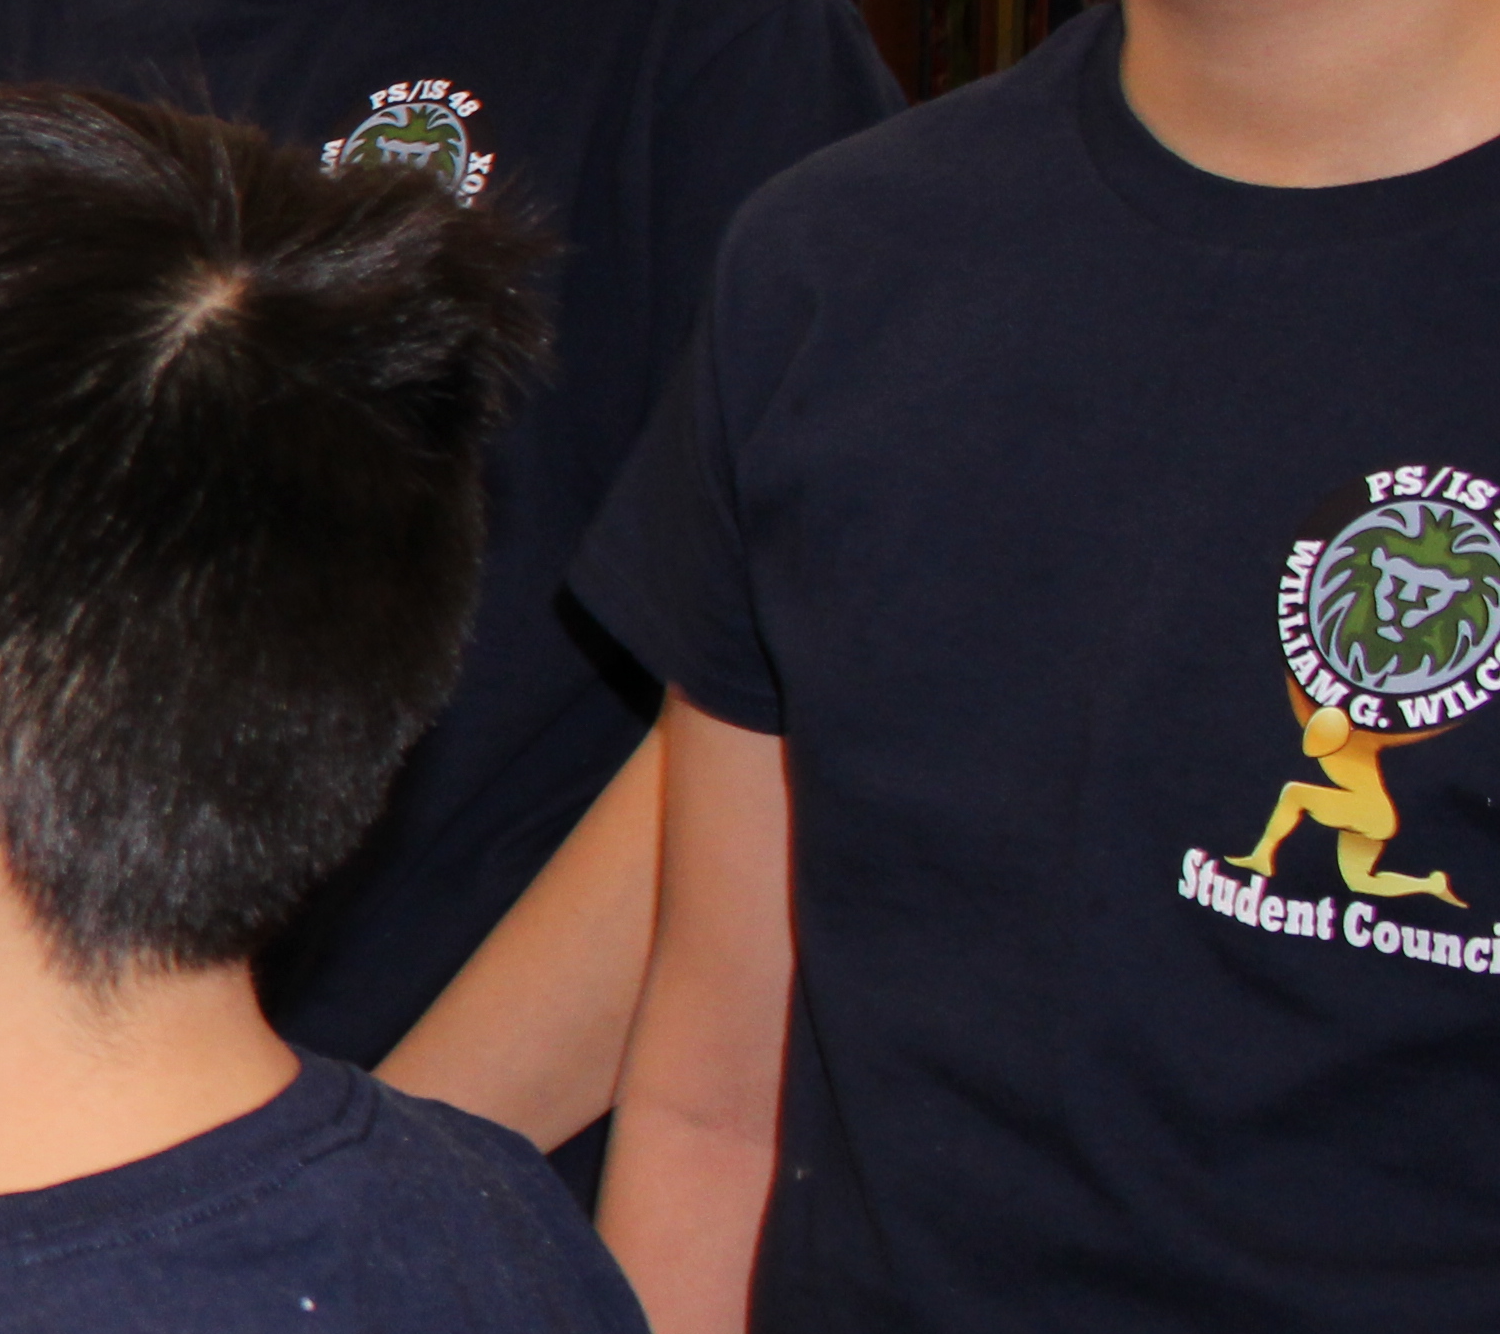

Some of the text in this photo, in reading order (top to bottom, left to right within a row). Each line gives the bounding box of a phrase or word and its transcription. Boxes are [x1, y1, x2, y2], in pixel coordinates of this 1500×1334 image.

[369, 78, 484, 118] PS/IS 48
[1364, 465, 1500, 511] PS/IS
[1277, 539, 1352, 708] WILLIAM
[1349, 693, 1392, 729] G.
[1178, 847, 1336, 941] Student
